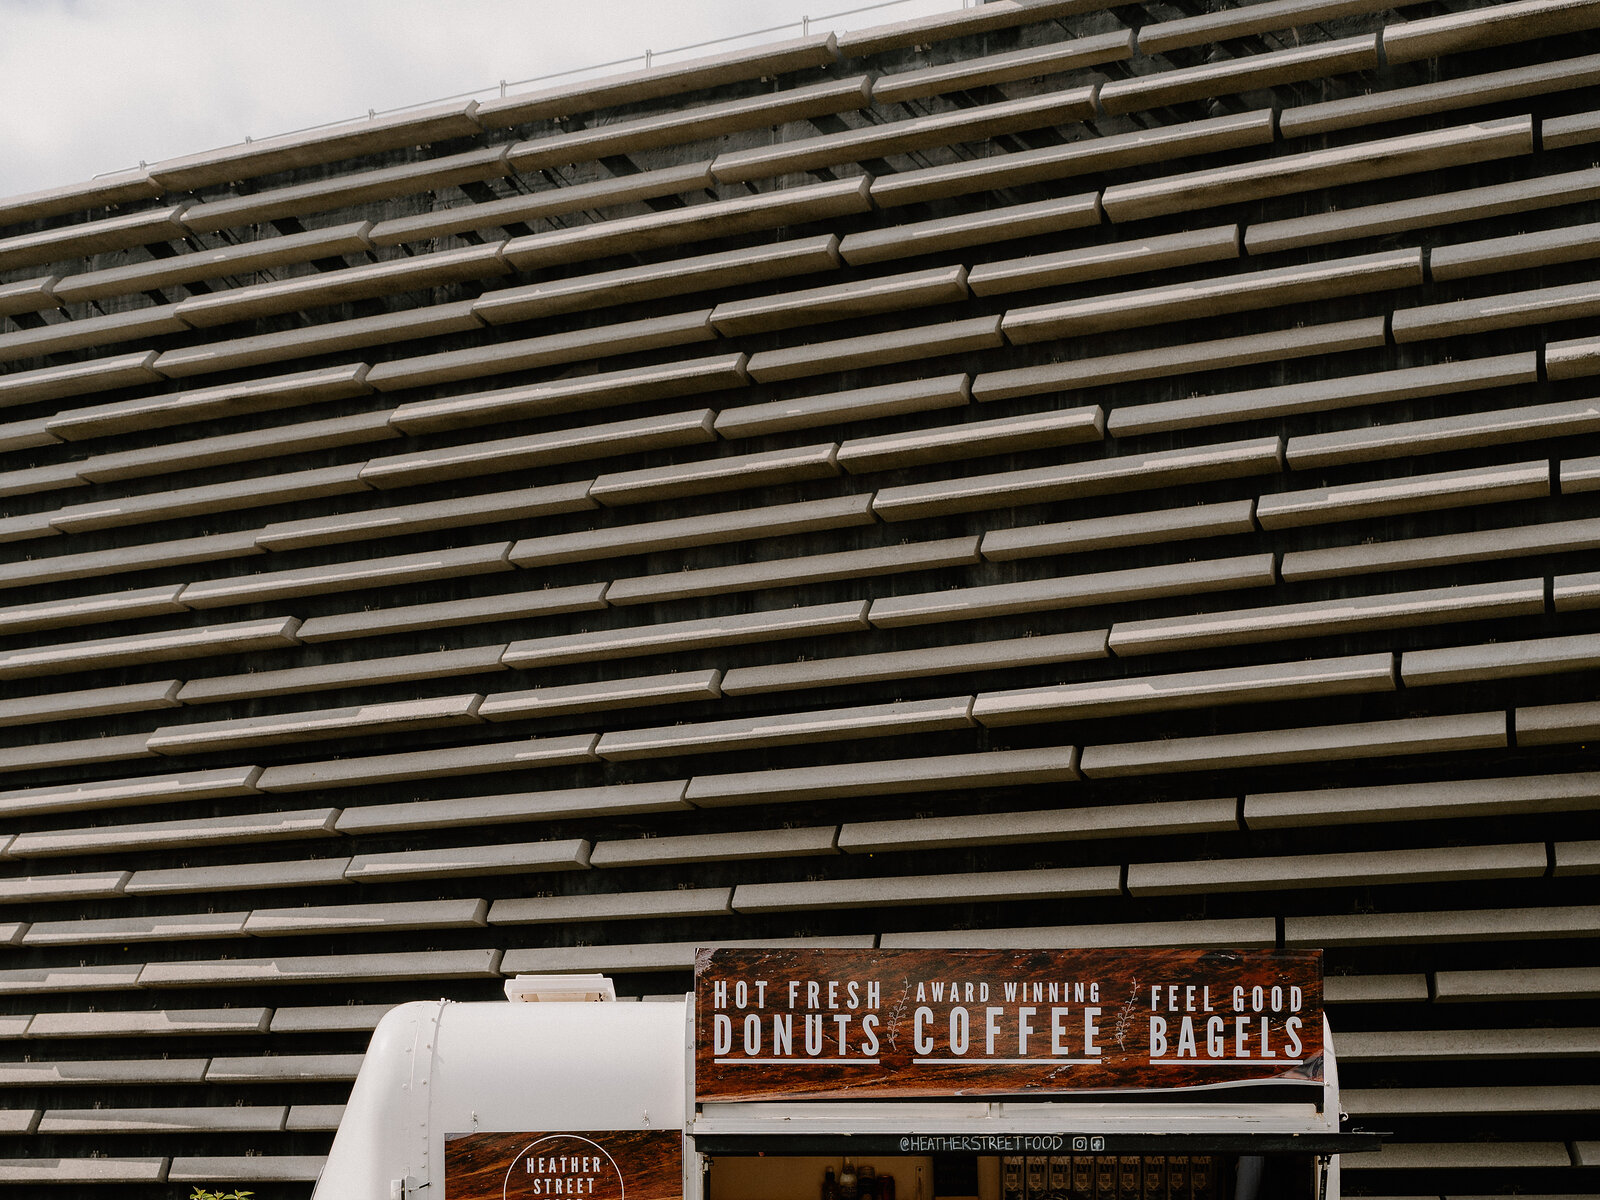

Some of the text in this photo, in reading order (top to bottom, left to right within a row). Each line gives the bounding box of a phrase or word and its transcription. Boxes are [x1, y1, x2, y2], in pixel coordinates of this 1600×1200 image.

[714, 981, 880, 1009] HOT FRESH
[916, 982, 1100, 1003] AWARD WINNING
[1151, 985, 1302, 1012] FEEL GOOD
[714, 1014, 880, 1056] DONUTS
[914, 1006, 1102, 1055] COFFEE
[1150, 1015, 1303, 1058] BAGELS
[900, 1136, 1063, 1151] @HEATHERSTREETFOOD
[526, 1156, 601, 1173] HEATHER
[533, 1177, 595, 1194] STREET
